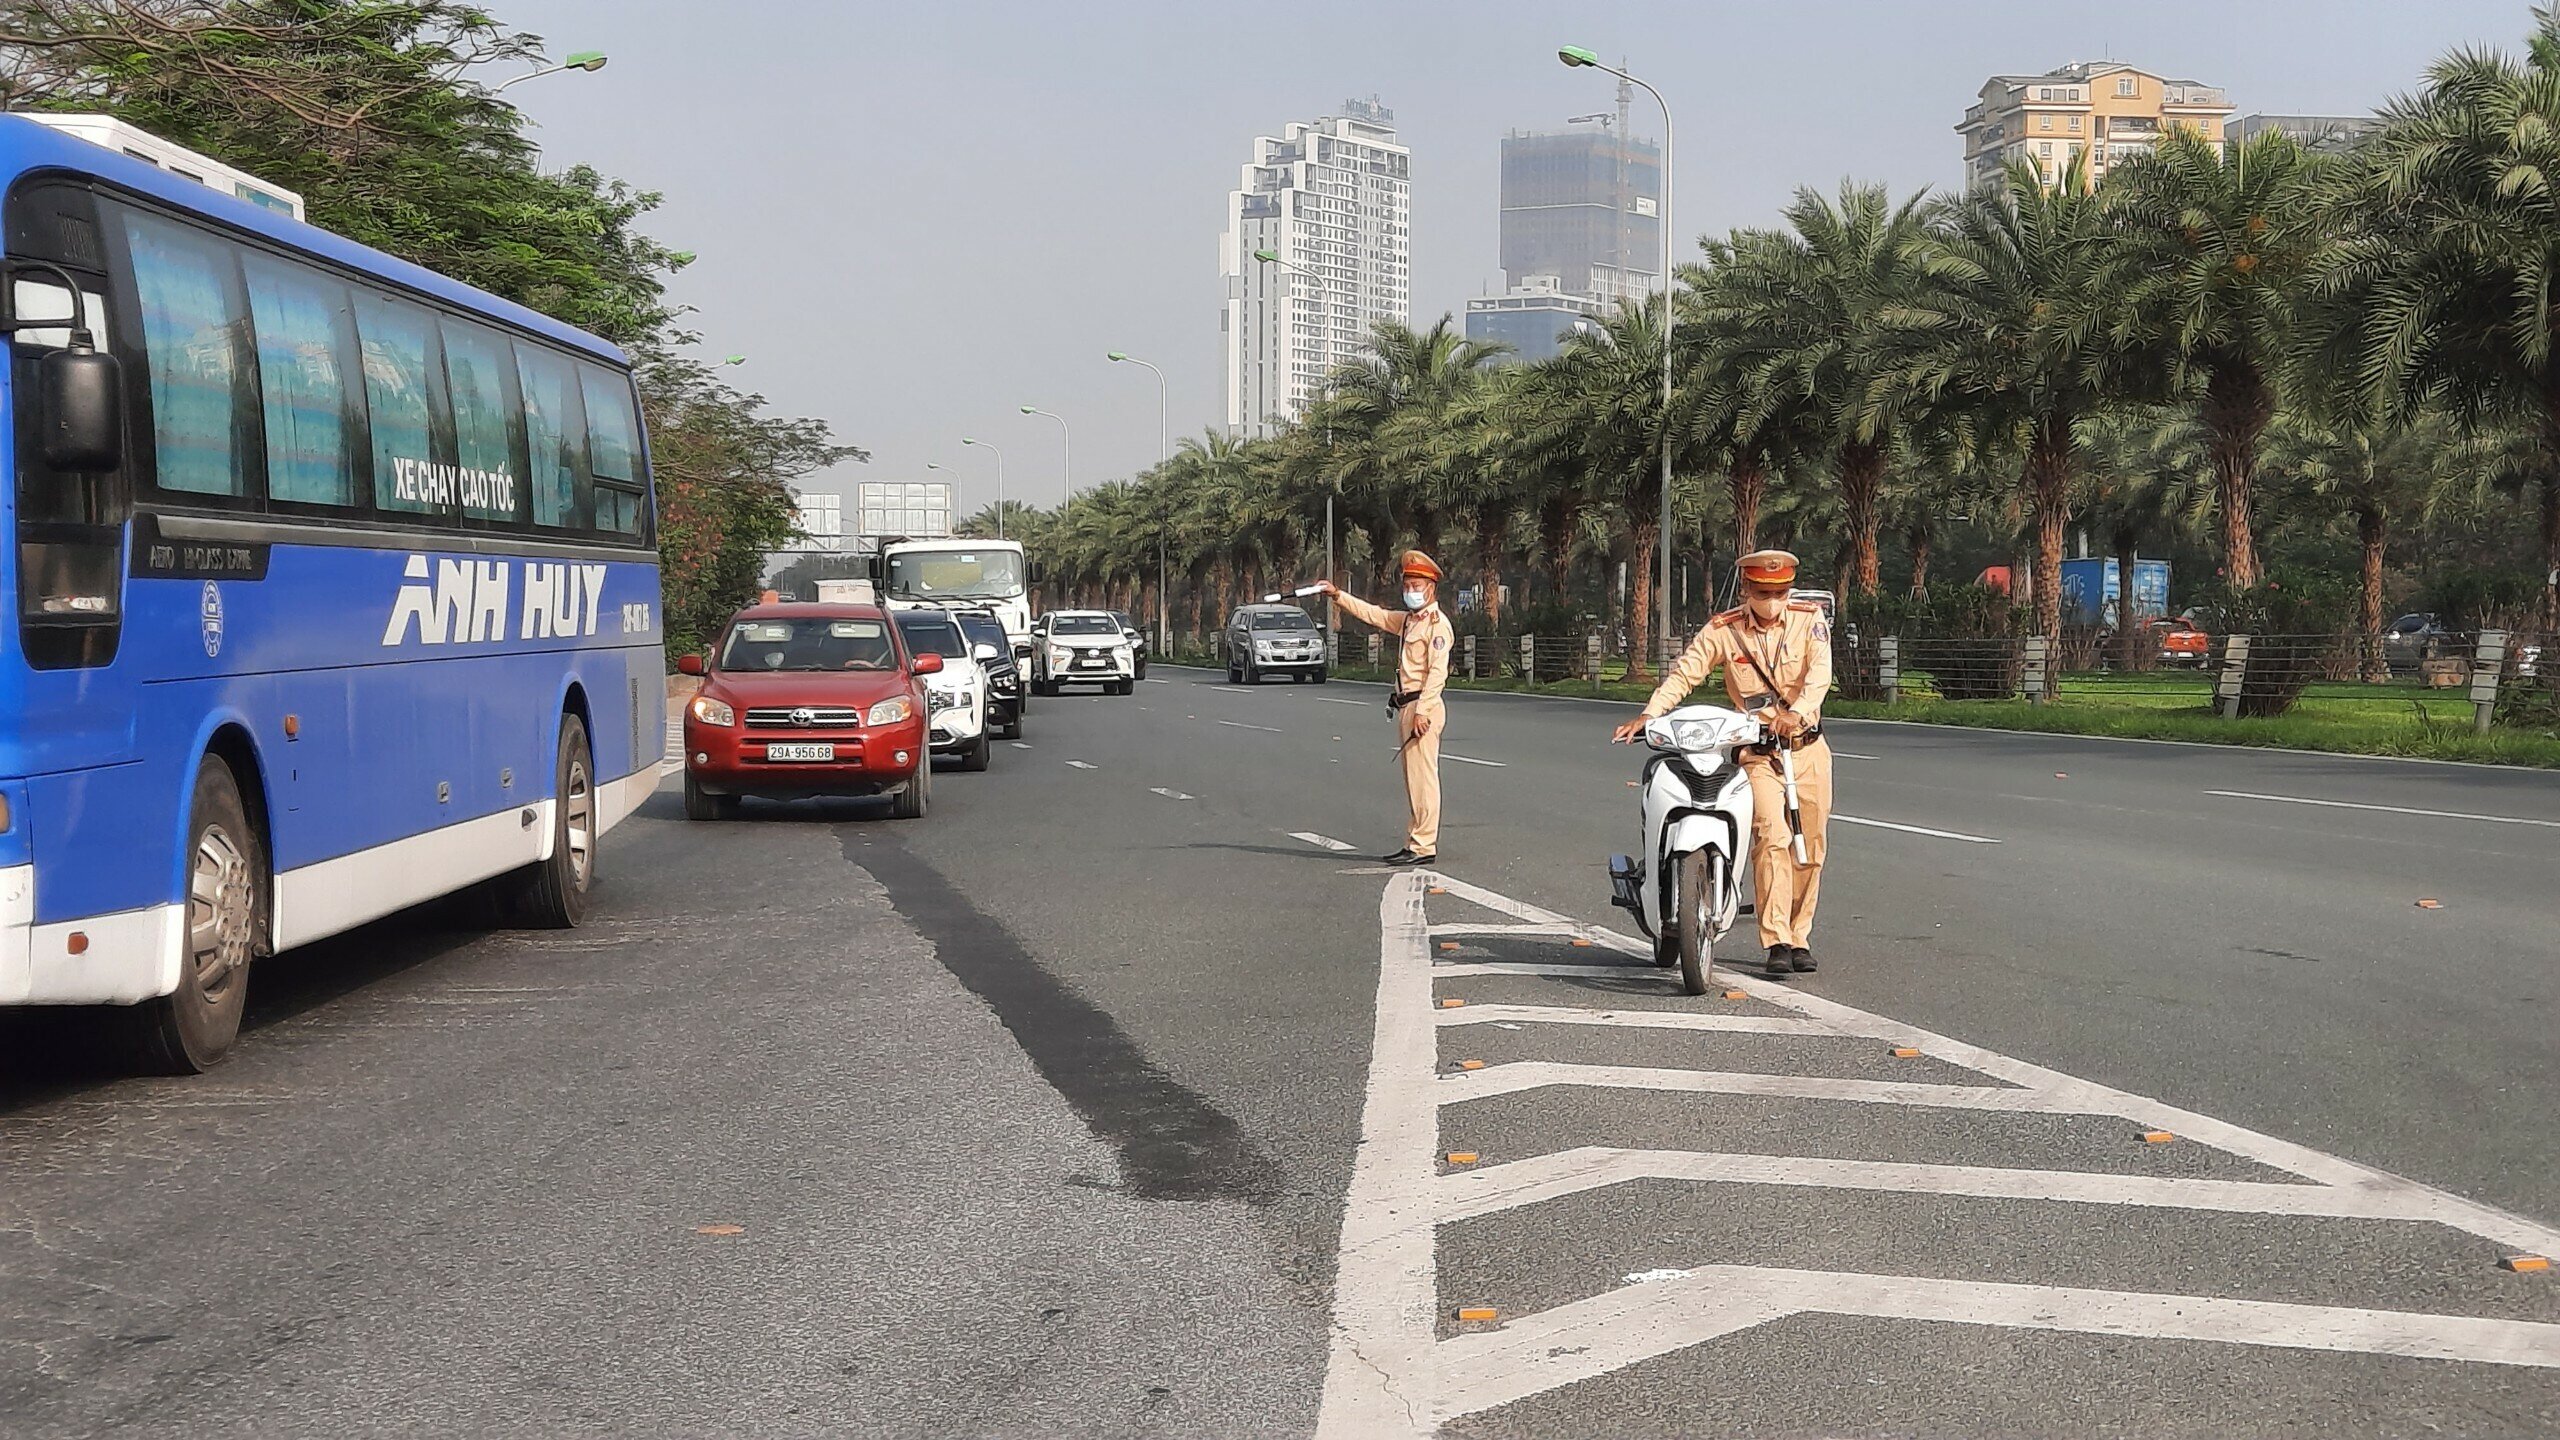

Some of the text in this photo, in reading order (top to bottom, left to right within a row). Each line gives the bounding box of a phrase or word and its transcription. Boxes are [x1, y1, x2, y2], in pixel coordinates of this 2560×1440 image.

[393, 456, 515, 514] XE CHẠY CAO TỐC
[521, 562, 607, 640] HUY
